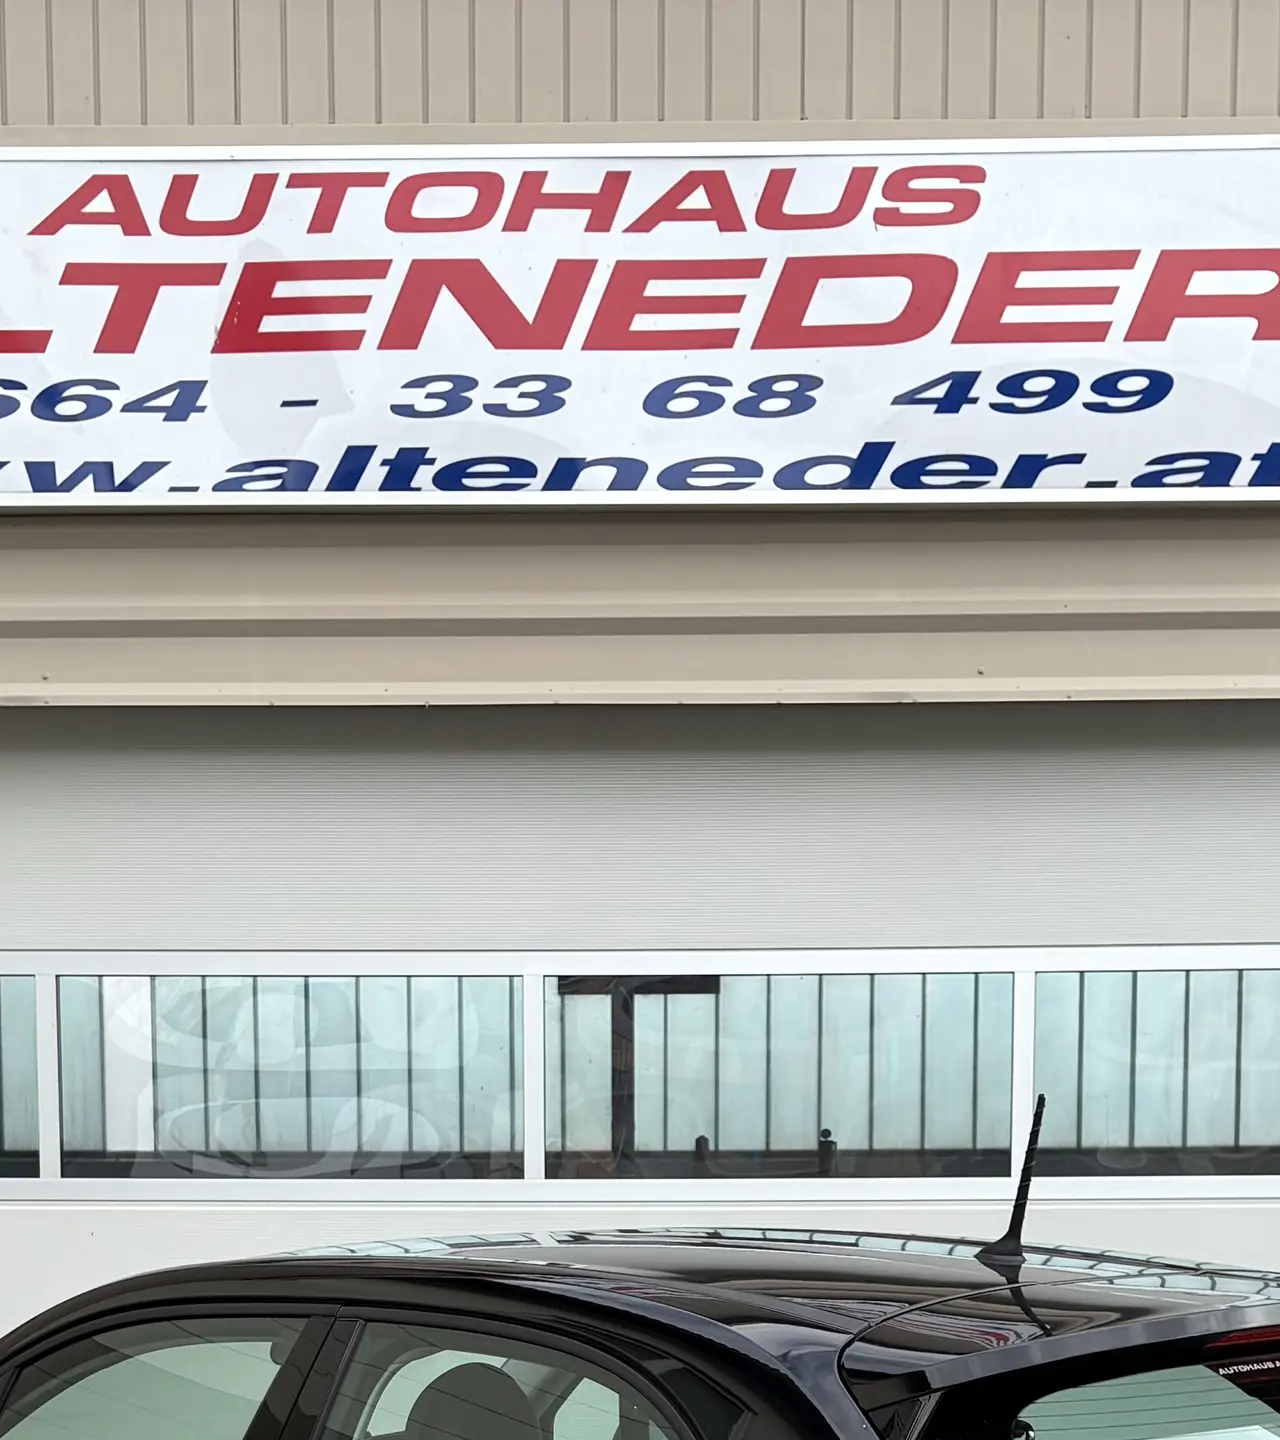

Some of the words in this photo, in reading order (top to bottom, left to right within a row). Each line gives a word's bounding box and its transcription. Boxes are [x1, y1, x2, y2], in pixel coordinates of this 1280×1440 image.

[28, 164, 988, 237] AUTOHAUS
[390, 374, 572, 419] 33
[642, 373, 824, 419] 68
[891, 369, 1175, 415] 499
[1218, 1362, 1274, 1375] AUTOHAUS
